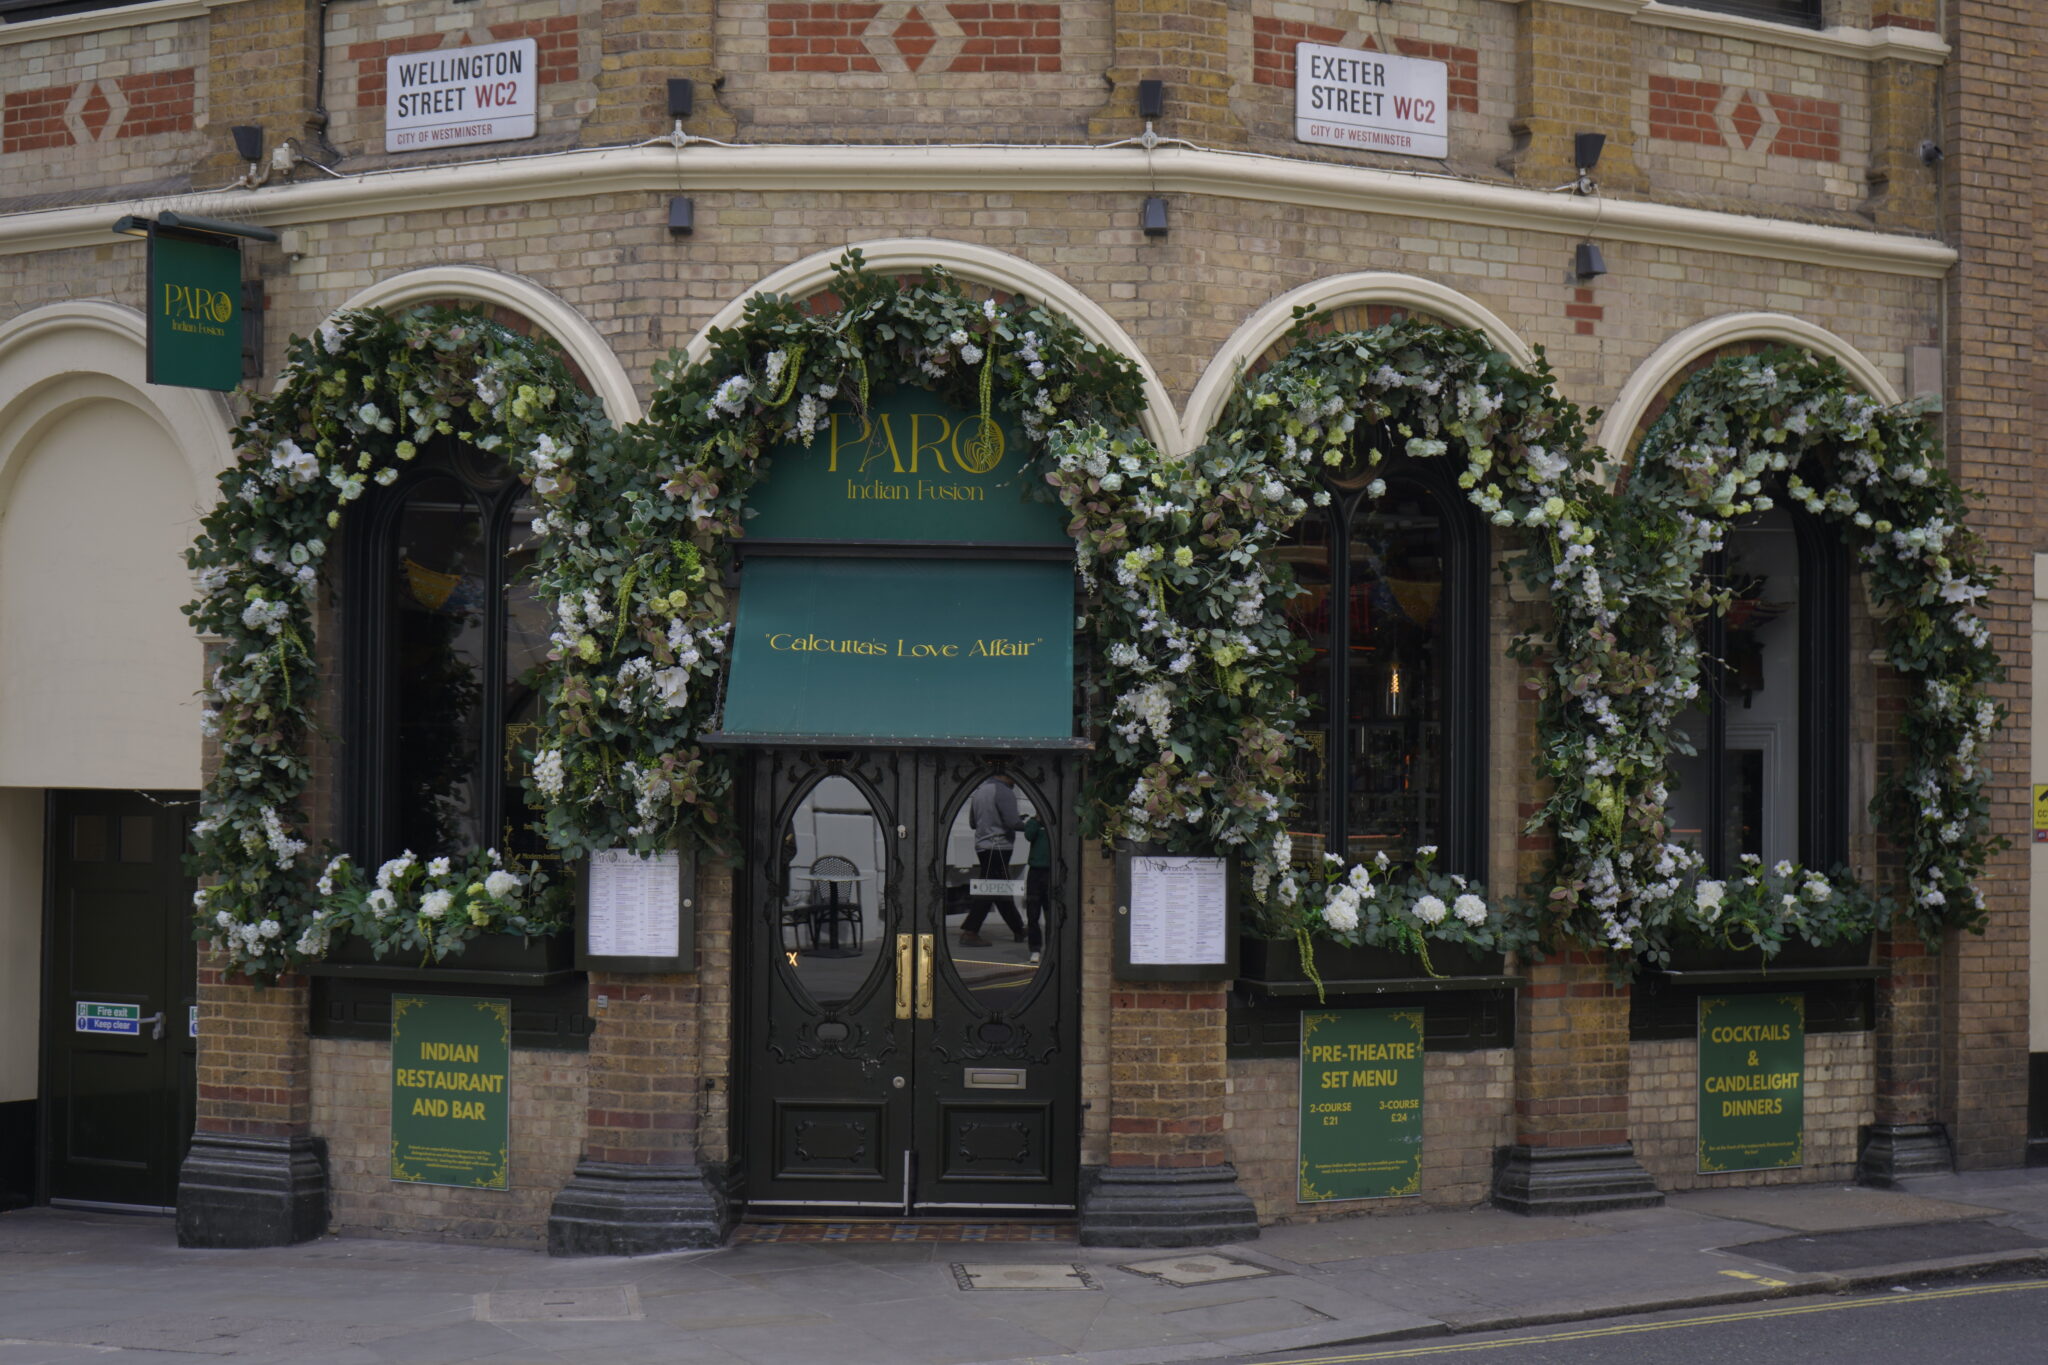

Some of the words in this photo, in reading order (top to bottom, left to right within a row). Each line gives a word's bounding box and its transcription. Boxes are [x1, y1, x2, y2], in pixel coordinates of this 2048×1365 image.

[399, 50, 522, 87] WELLINGTON
[1311, 55, 1385, 87] EXETER
[398, 87, 466, 118] STREET
[475, 81, 517, 109] WC2
[1311, 85, 1384, 117] STREET
[1393, 95, 1436, 124] WC2
[397, 132, 415, 145] CITY
[418, 130, 429, 143] OF
[431, 123, 493, 141] WESTMINSTER
[1310, 124, 1331, 137] CITY
[1334, 127, 1345, 139] OF
[1348, 129, 1412, 148] WESTMINSTER
[164, 283, 232, 323] PARO
[172, 319, 197, 334] Indian
[198, 322, 226, 337] Fusion
[827, 412, 1005, 474] PARO
[847, 479, 909, 500] Indian
[918, 479, 984, 501] Fusion
[896, 639, 960, 657] Love
[980, 882, 1014, 893] OPEN
[97, 1006, 112, 1016] Fire
[113, 1008, 128, 1017] exit
[94, 1019, 112, 1030] Keep
[113, 1020, 131, 1030] clear
[1711, 1024, 1790, 1043] COCKTAILS
[420, 1042, 479, 1063] INDIAN
[1312, 1043, 1415, 1062] PRE-THEATRE
[1747, 1050, 1759, 1066] &
[397, 1069, 503, 1093] RESTAURANT
[1321, 1071, 1349, 1088] SET
[1352, 1069, 1398, 1088] MENU
[1705, 1073, 1799, 1093] CANDLELIGHT
[412, 1098, 448, 1117] AND
[452, 1101, 486, 1121] BAR
[1310, 1102, 1352, 1113] 2-COURSE
[1379, 1099, 1419, 1110] 3-COURSE
[1722, 1098, 1782, 1117] DINNERS
[1323, 1116, 1339, 1126] £21
[1391, 1113, 1407, 1122] £24
